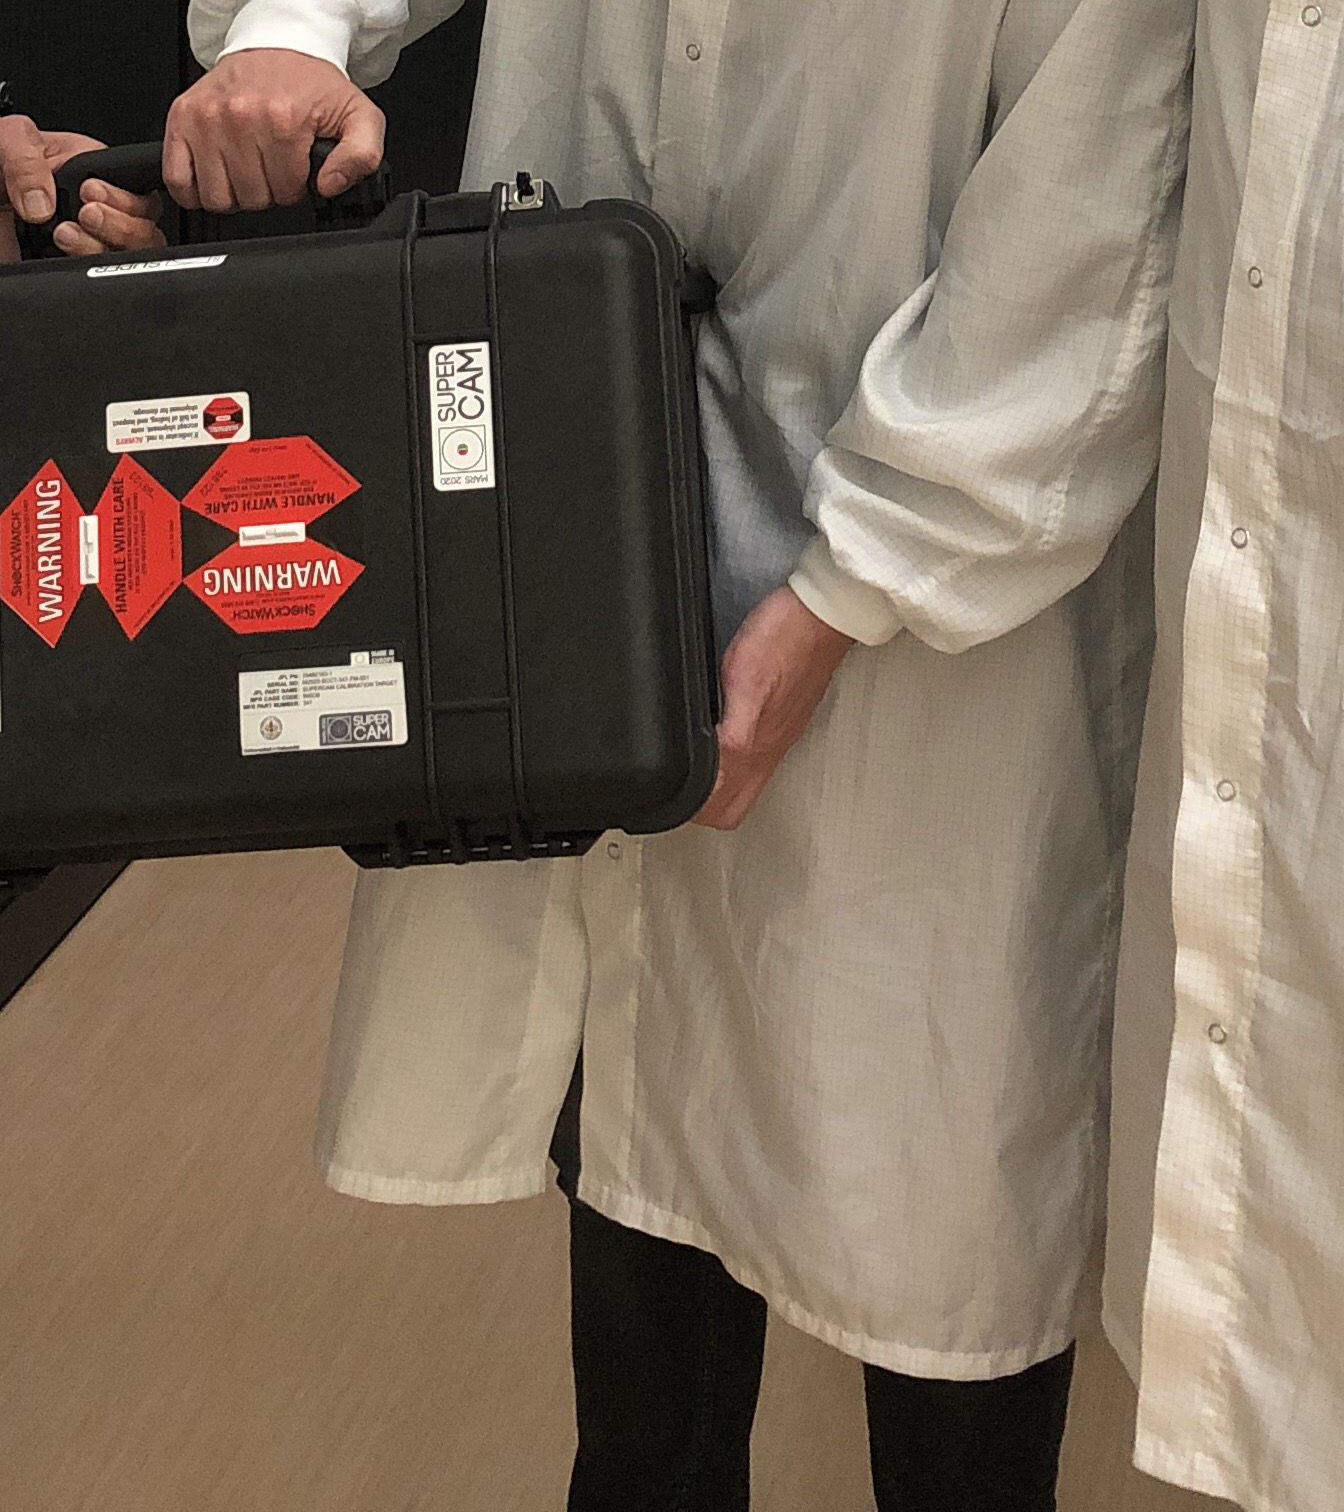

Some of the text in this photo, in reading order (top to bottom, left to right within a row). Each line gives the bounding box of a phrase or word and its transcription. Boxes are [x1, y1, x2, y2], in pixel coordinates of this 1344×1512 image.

[435, 350, 457, 422] SUPER
[455, 347, 486, 420] CAM
[440, 474, 489, 486] MARS 2020
[205, 500, 239, 515] CARE
[243, 497, 278, 512] WITH
[282, 491, 336, 508] HANDLE
[35, 479, 63, 623] WARNING
[111, 476, 128, 613] HANDLE WITH CARE
[203, 559, 342, 596] WARNING
[352, 713, 389, 727] SUPER
[353, 724, 391, 741] CAM
